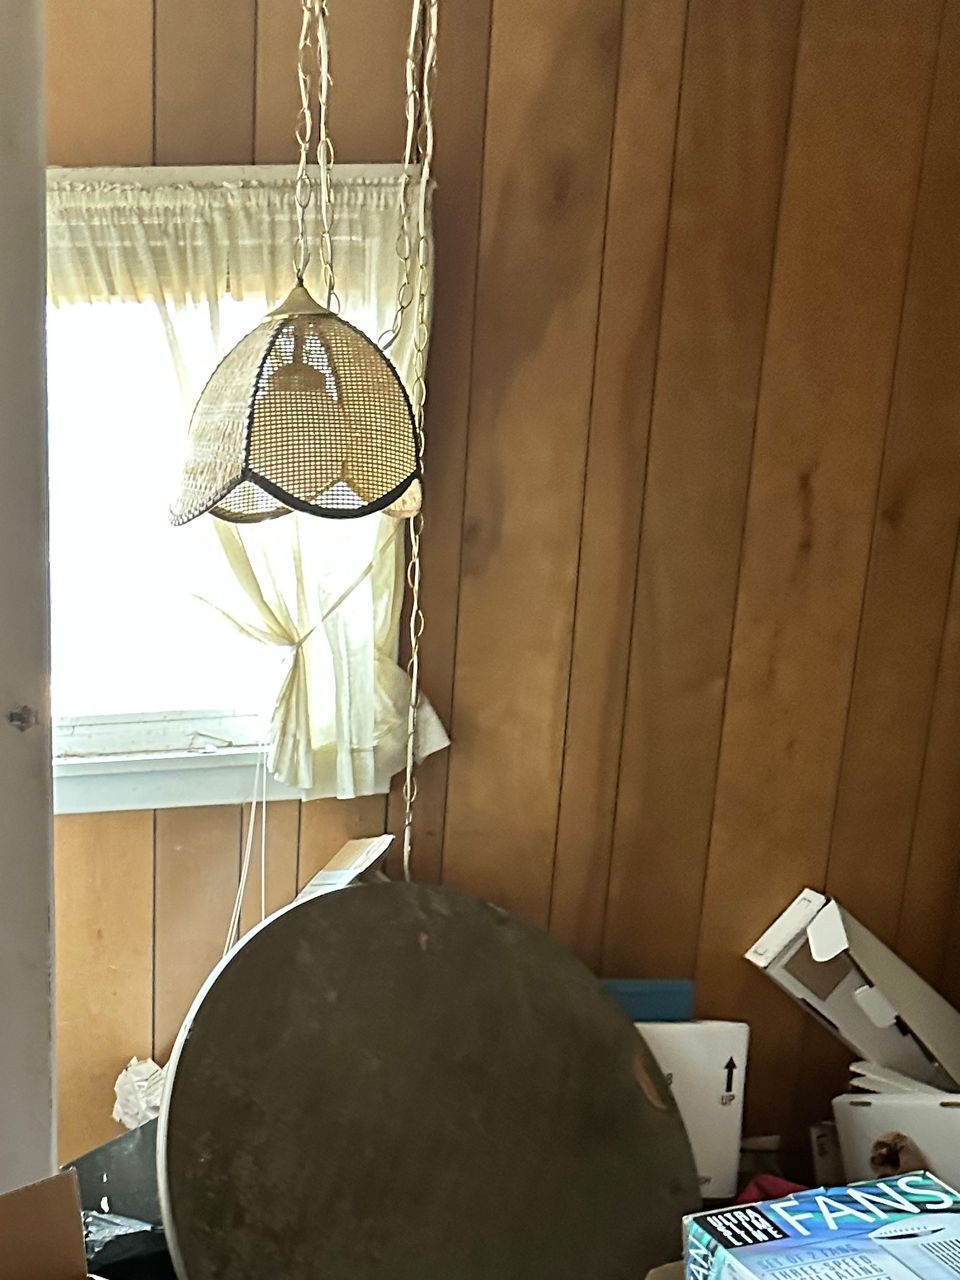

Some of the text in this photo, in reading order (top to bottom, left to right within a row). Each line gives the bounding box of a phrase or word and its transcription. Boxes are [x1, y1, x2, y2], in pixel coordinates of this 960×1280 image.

[720, 1095, 736, 1107] UP
[770, 1176, 953, 1236] FANS
[706, 1208, 762, 1229] ULTRA
[726, 1227, 783, 1247] LINE
[757, 1255, 783, 1270] SET
[789, 1253, 807, 1265] OF
[819, 1243, 862, 1258] FANS
[769, 1255, 874, 1280] THREE-SPEED
